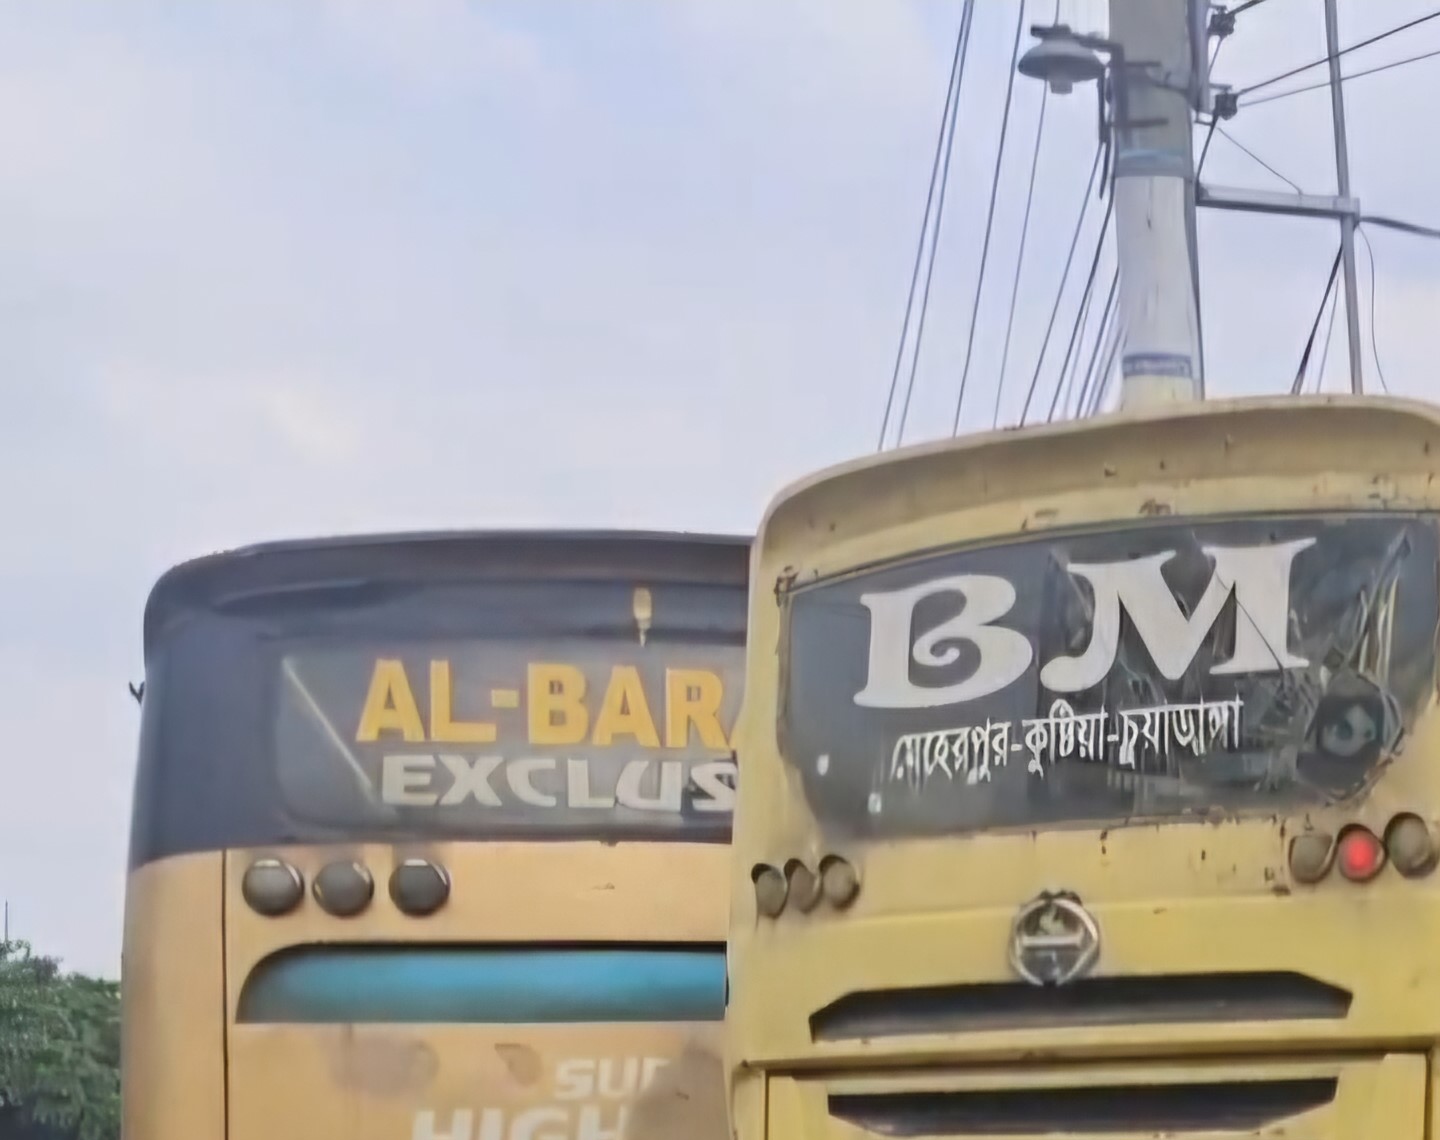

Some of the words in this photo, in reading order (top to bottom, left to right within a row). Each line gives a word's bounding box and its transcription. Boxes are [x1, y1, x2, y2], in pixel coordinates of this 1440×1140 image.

[852, 536, 1318, 709] BM
[355, 658, 738, 750] AL-BAR
[382, 754, 738, 812] EXCLUS
